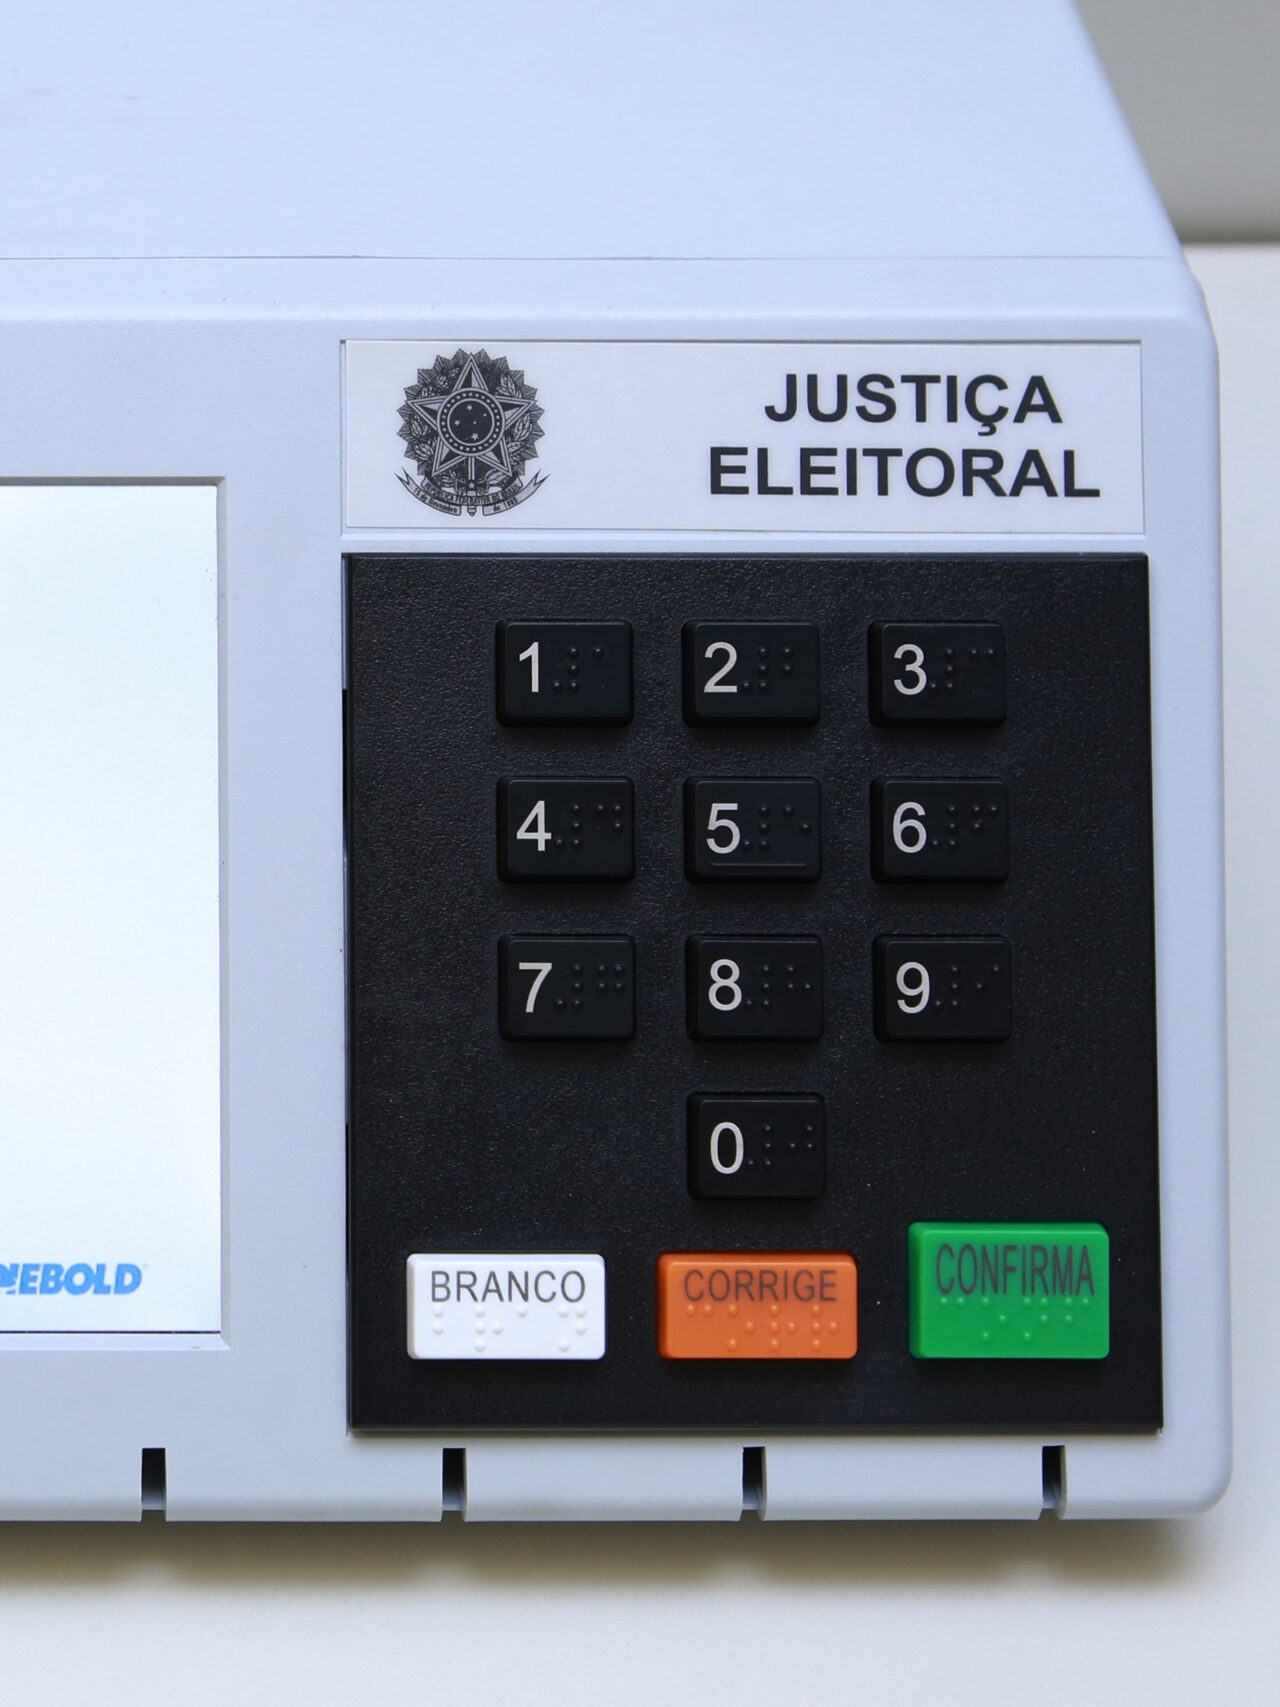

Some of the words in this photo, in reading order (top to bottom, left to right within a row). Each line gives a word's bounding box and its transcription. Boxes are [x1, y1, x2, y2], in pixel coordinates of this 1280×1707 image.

[764, 373, 1063, 437] JUSTIÇA
[709, 446, 1101, 498] ELEITORAL
[519, 641, 539, 693] 1
[703, 641, 738, 693] 2
[894, 643, 927, 695] 3
[516, 800, 552, 852] 4
[706, 802, 741, 854] 5
[892, 801, 927, 854] 6
[518, 962, 553, 1013] 7
[708, 958, 742, 1011] 8
[896, 961, 930, 1014] 9
[710, 1121, 744, 1175] 0
[431, 1270, 586, 1303] BRANCO
[683, 1269, 838, 1302] CORRIGE
[935, 1243, 1096, 1297] CONFIRMA
